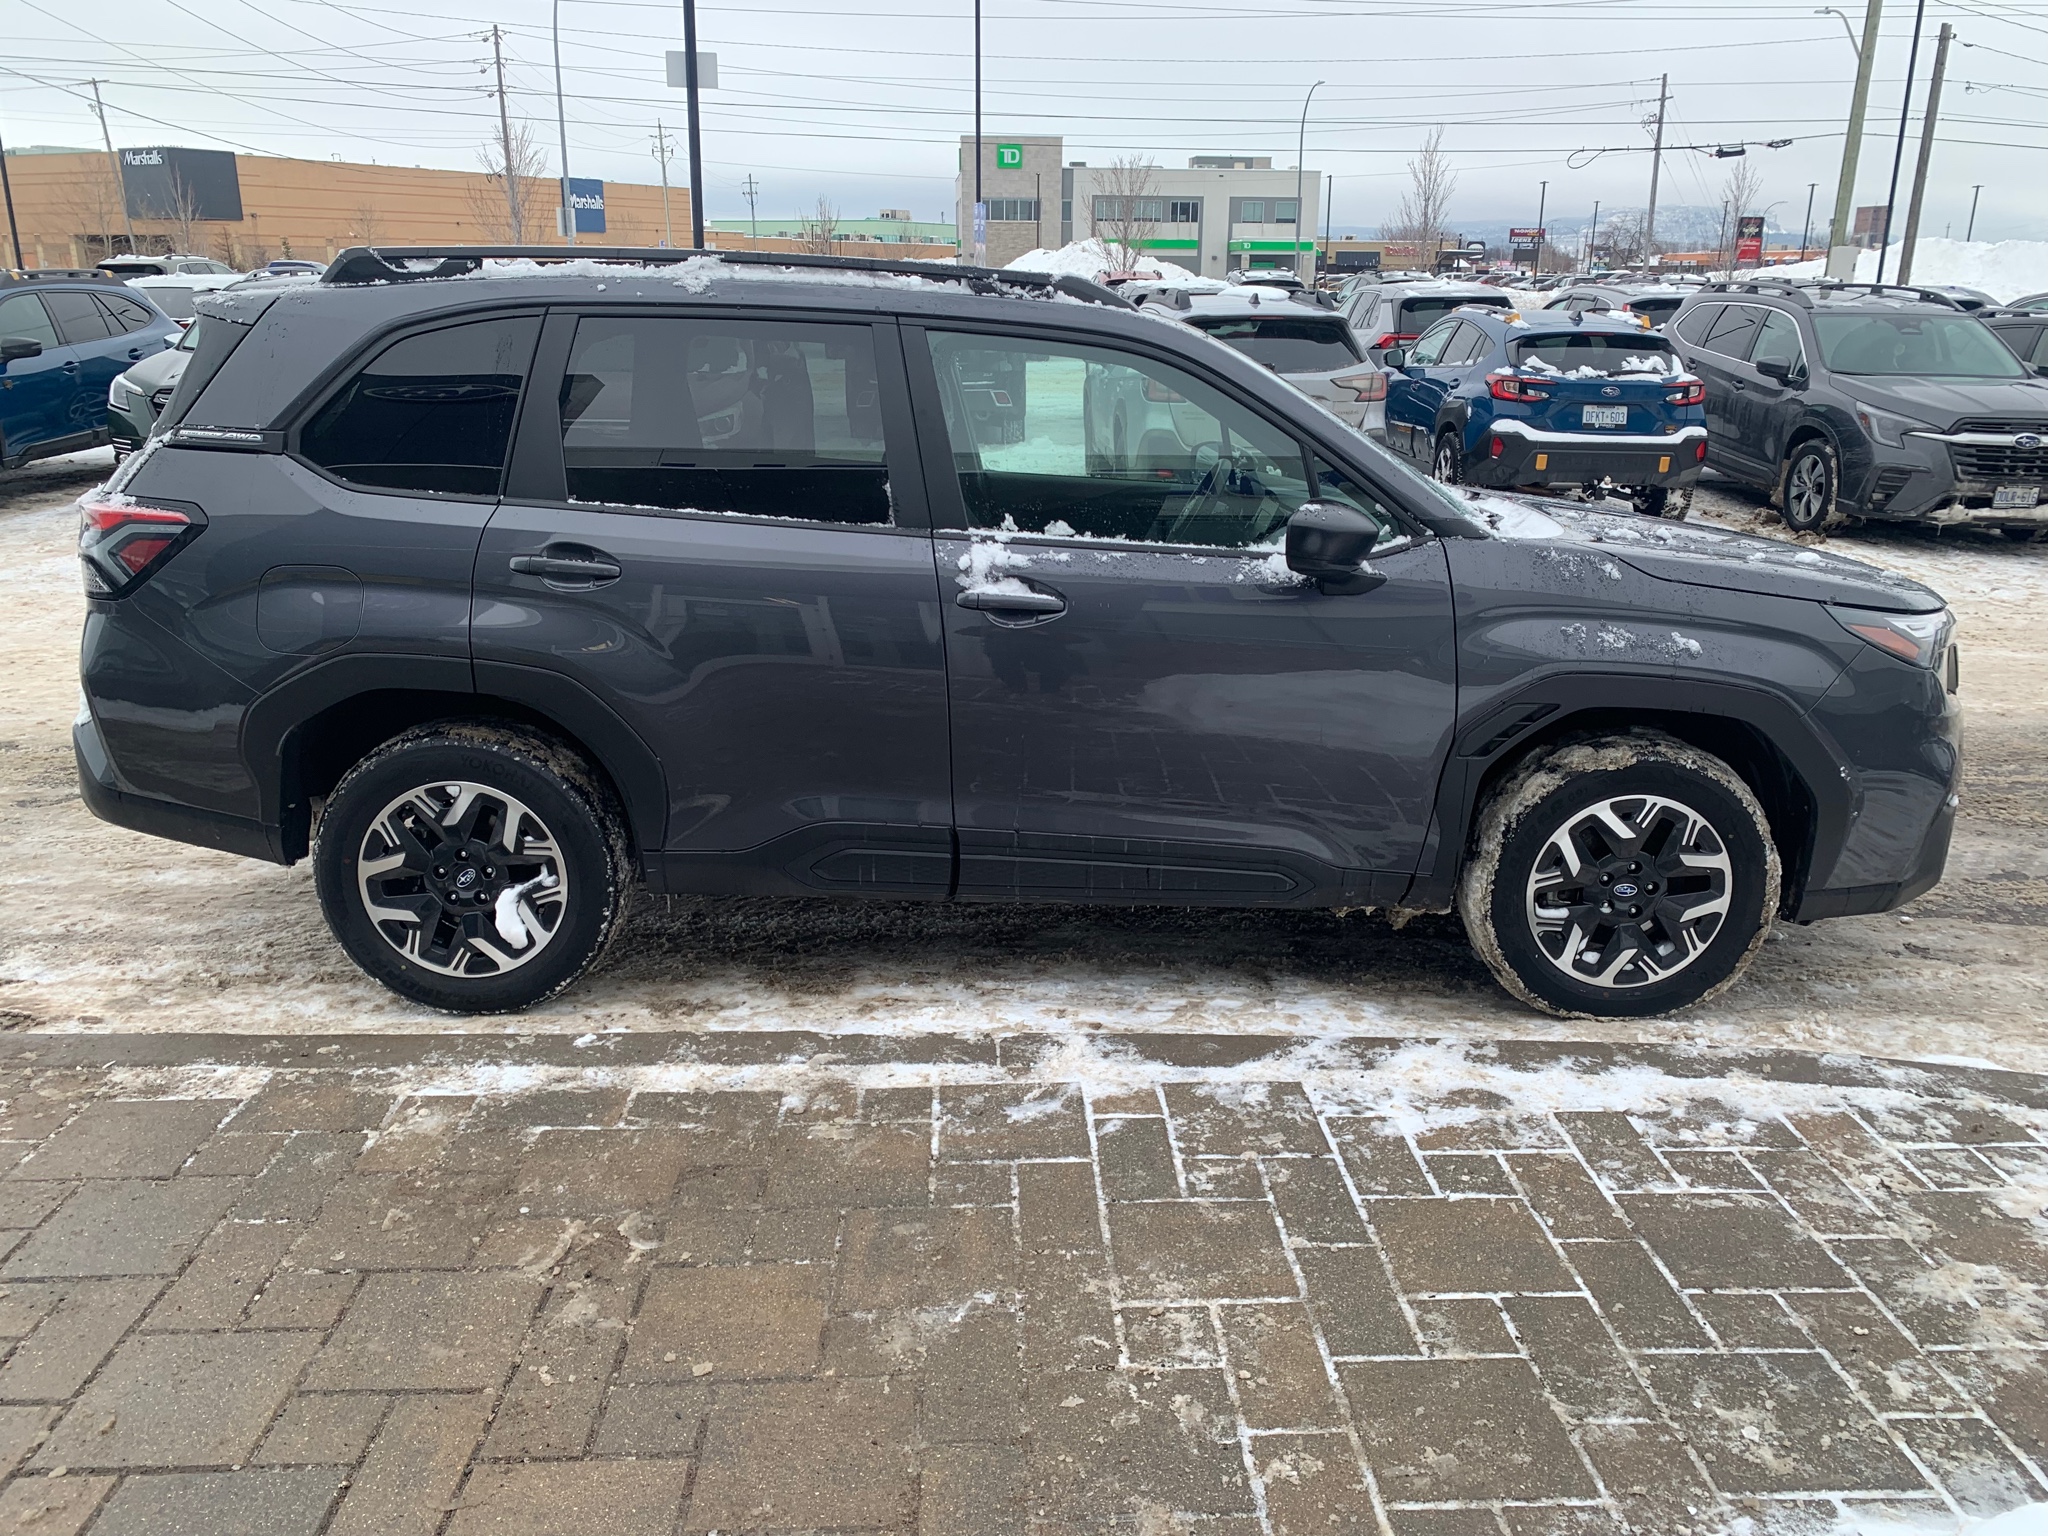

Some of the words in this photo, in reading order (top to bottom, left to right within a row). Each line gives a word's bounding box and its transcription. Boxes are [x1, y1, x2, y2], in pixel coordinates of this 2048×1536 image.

[123, 150, 162, 165] Marshalls
[1000, 149, 1020, 163] TD
[570, 193, 604, 209] Marshalls
[1585, 411, 1605, 422] DFKT
[1610, 412, 1625, 423] 603
[222, 432, 262, 441] AWD
